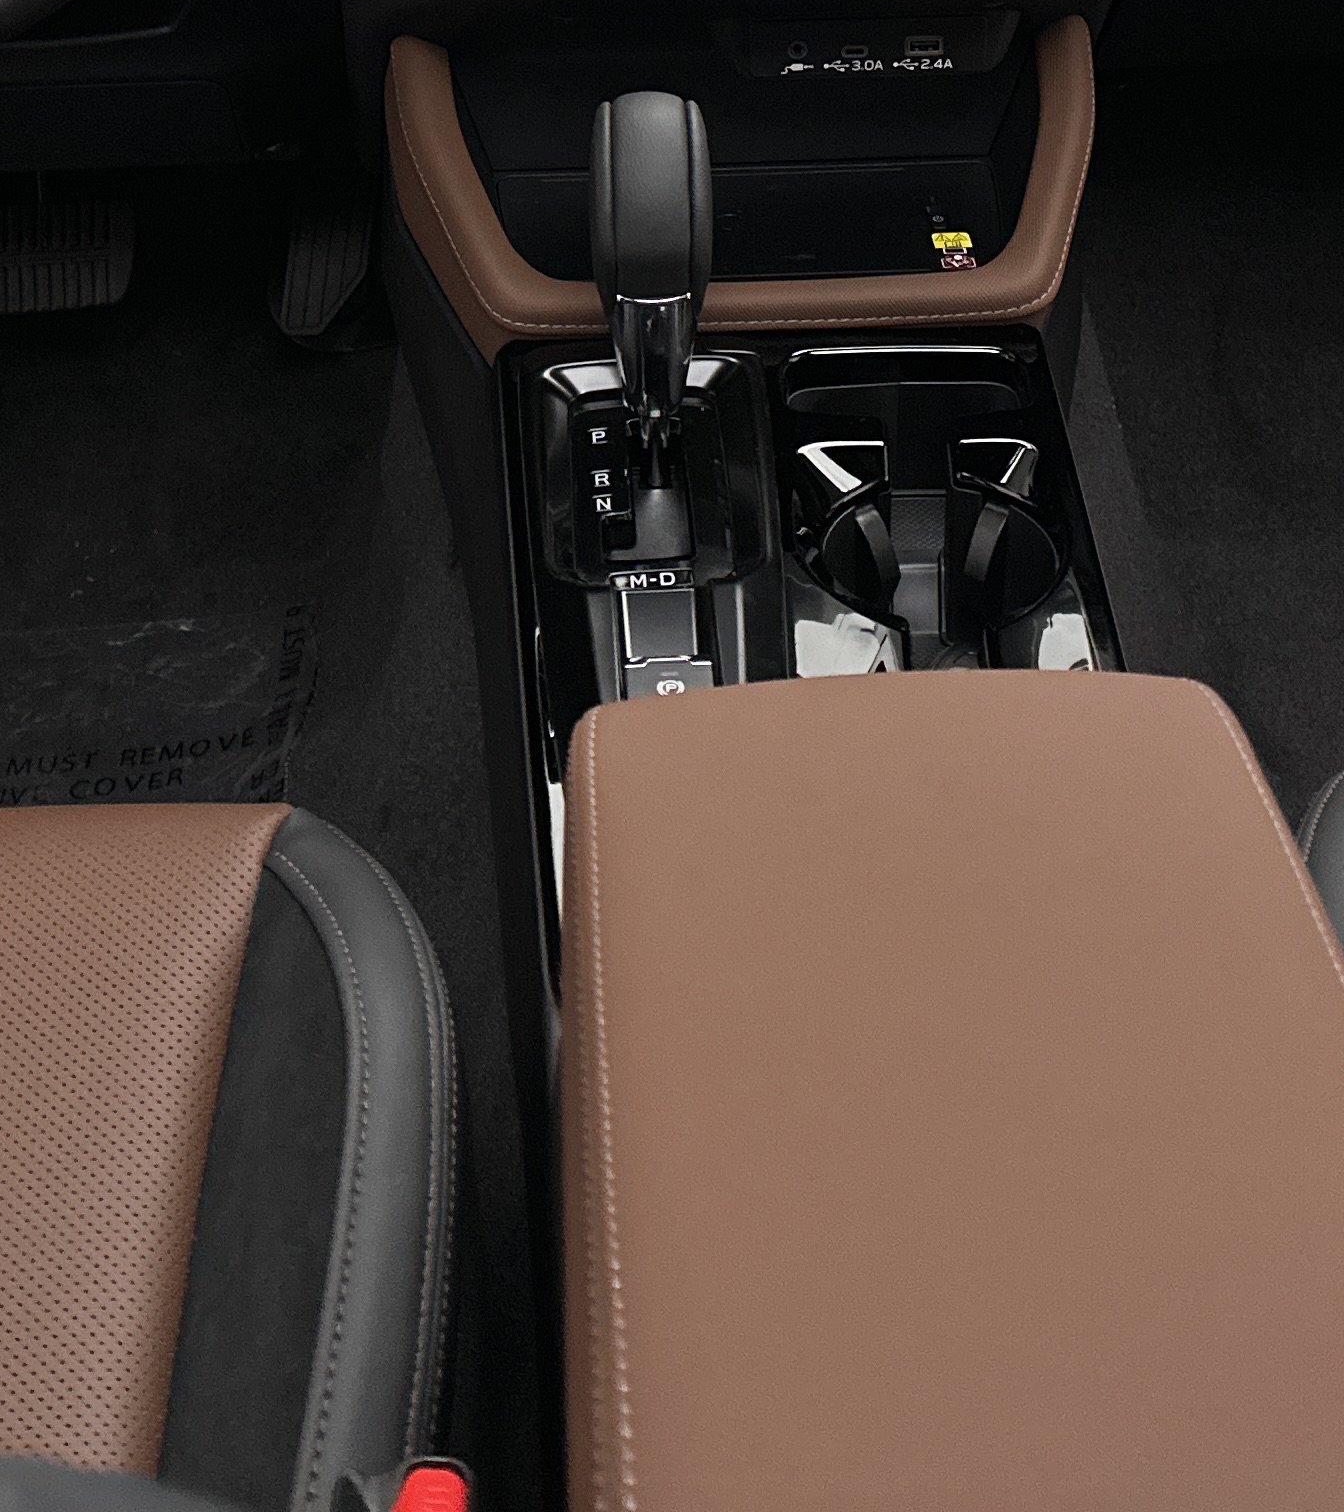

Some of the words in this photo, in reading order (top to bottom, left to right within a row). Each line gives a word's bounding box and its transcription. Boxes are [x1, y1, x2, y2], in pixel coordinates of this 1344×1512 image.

[852, 60, 884, 71] 3.0A
[920, 58, 954, 70] 2.4A
[591, 431, 606, 444] P
[594, 473, 610, 487] R
[596, 497, 612, 511] N
[6, 746, 100, 776] MUST
[119, 726, 256, 767] REMOVE
[69, 767, 183, 800] COVER
